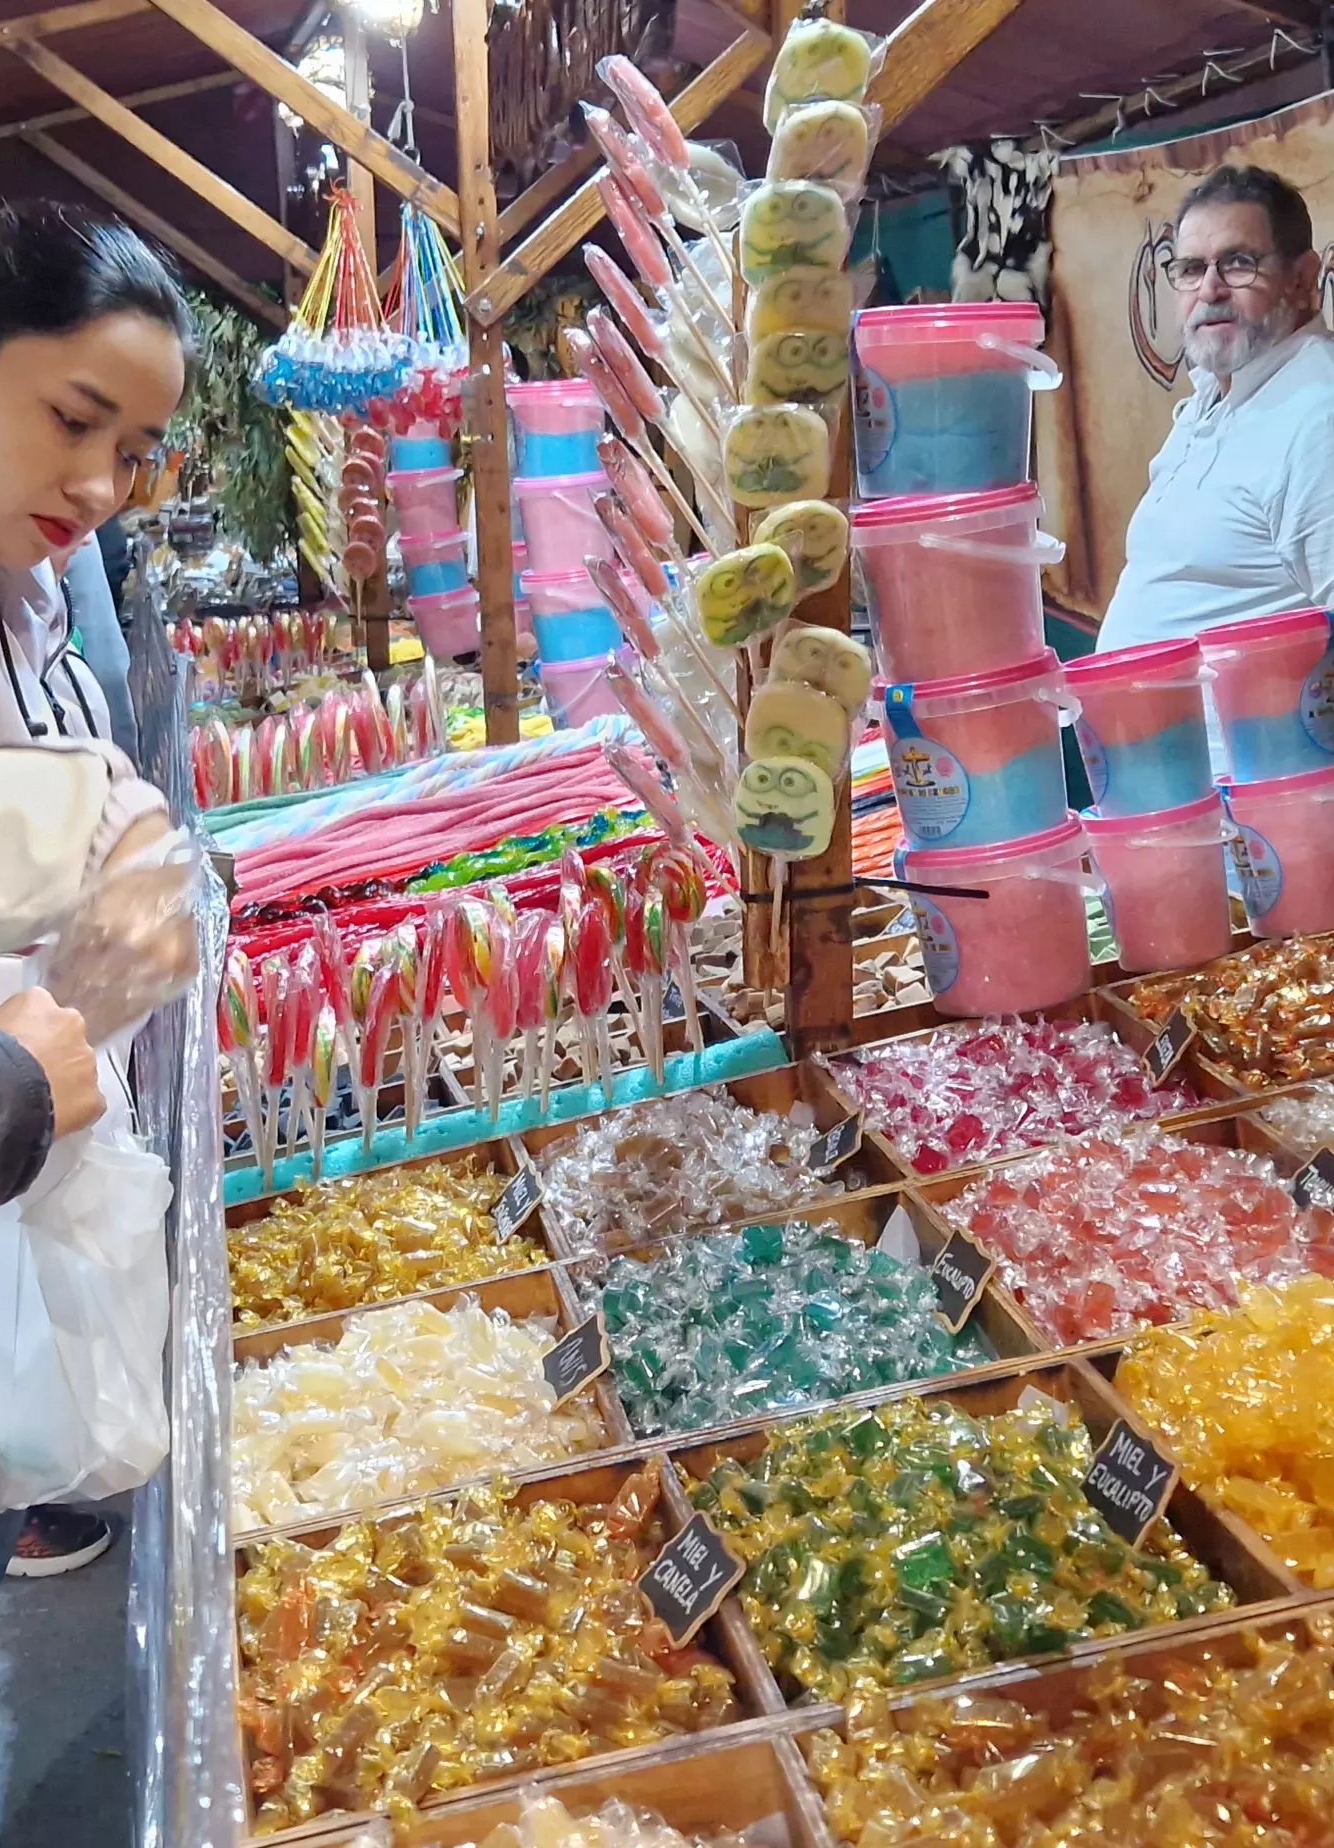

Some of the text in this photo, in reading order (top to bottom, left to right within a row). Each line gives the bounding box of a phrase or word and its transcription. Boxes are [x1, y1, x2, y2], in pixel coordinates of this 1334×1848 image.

[1108, 1430, 1168, 1492] MIEL Y
[1087, 1462, 1155, 1523] EUCALIPTO
[653, 1558, 700, 1616] CANELA
[677, 1528, 724, 1592] MIEL Y
